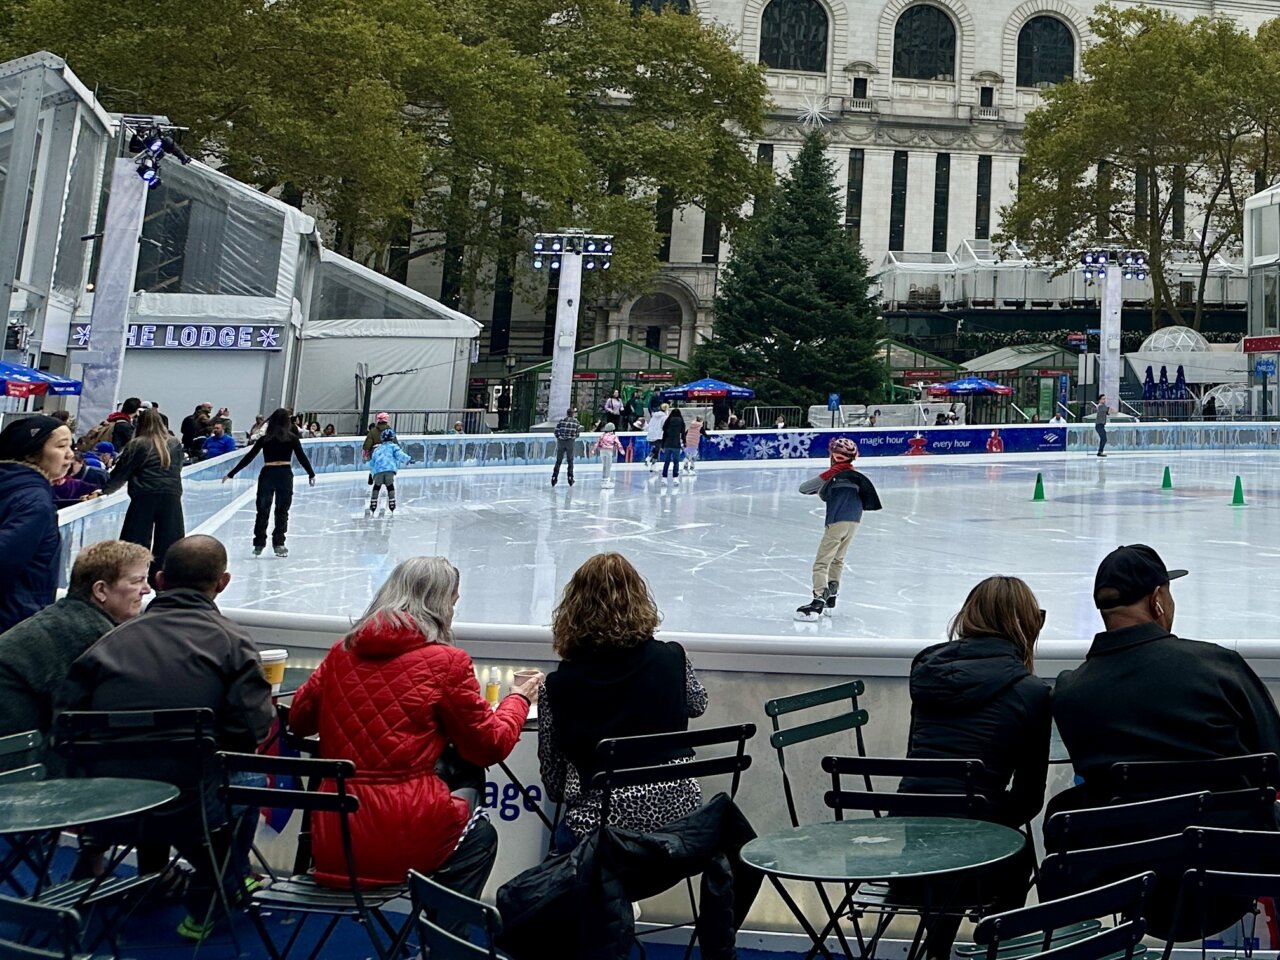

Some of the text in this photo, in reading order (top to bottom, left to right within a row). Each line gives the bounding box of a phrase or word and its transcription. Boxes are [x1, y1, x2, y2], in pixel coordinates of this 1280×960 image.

[126, 325, 253, 347] HE LODGE
[860, 436, 904, 446] magic hour
[932, 440, 971, 449] every hour
